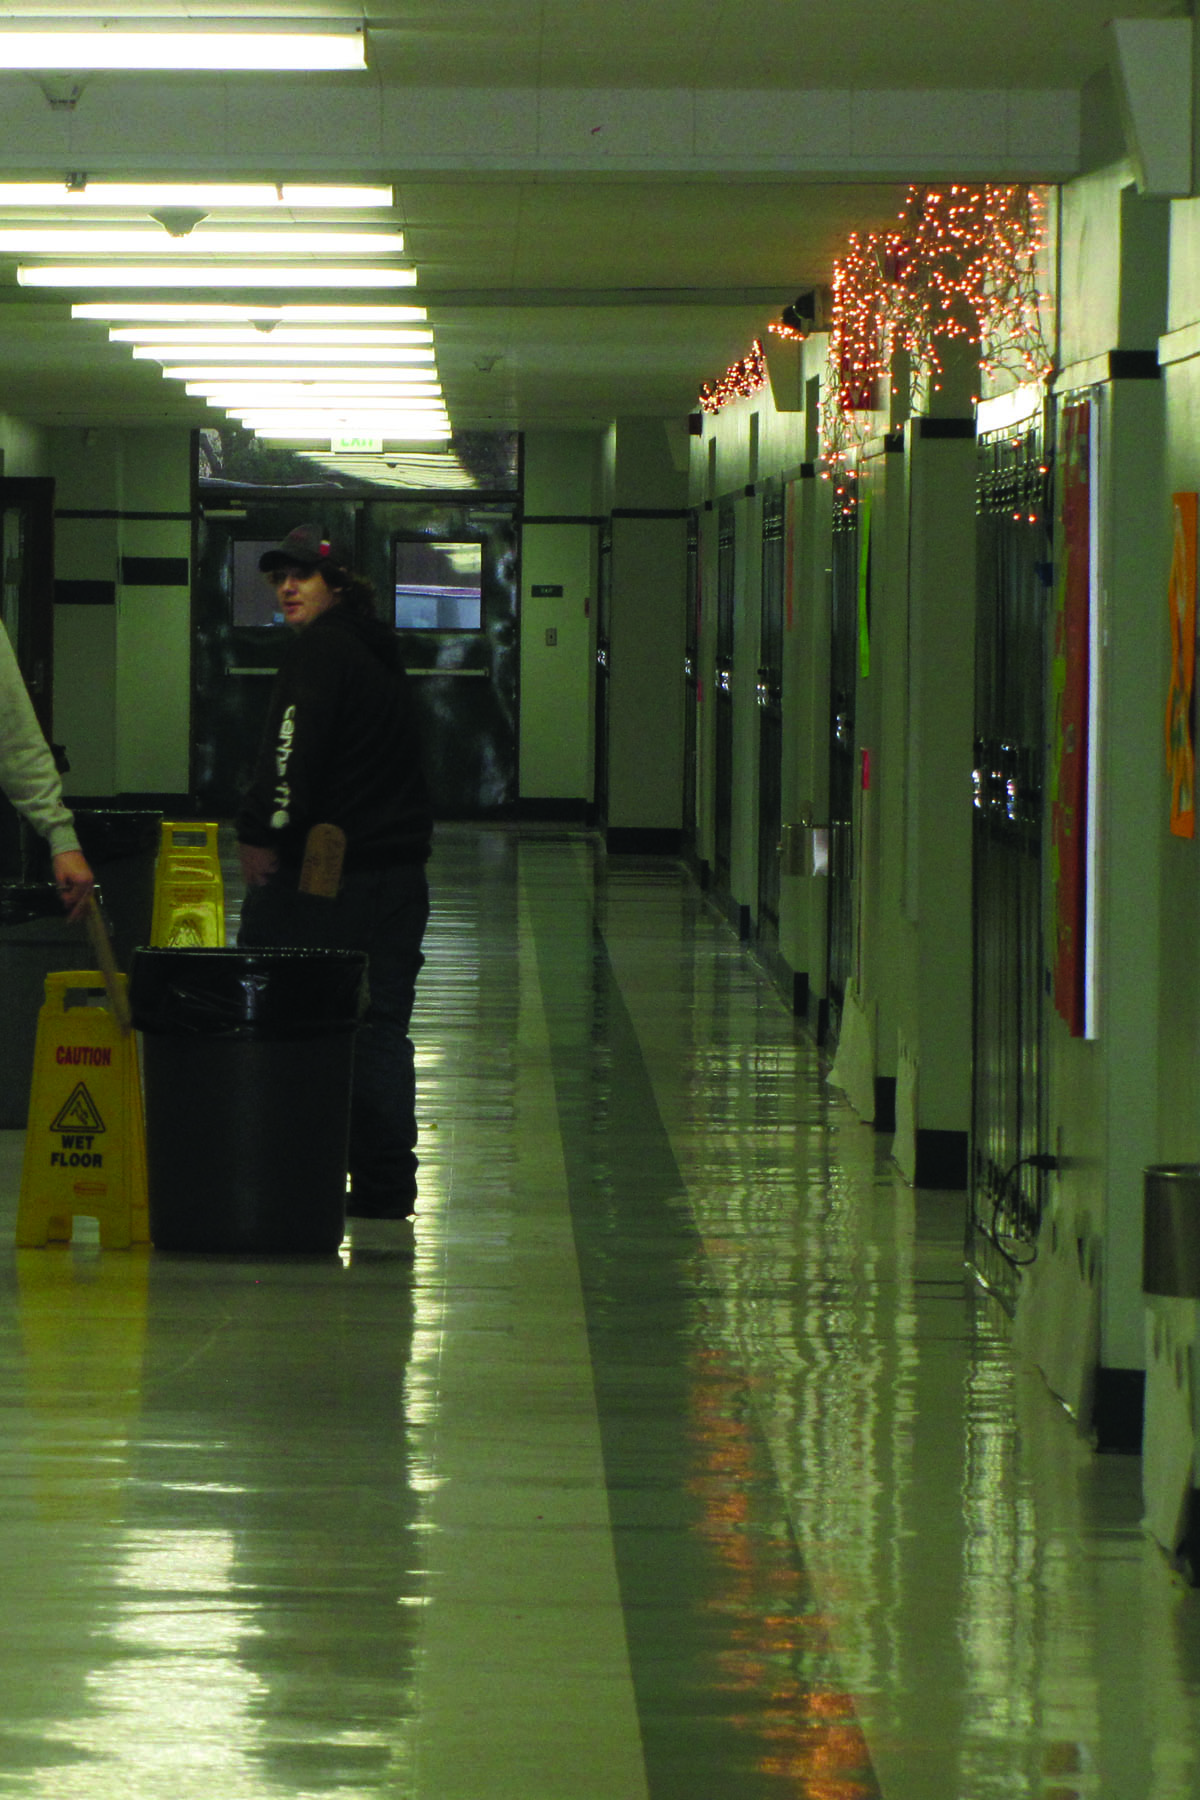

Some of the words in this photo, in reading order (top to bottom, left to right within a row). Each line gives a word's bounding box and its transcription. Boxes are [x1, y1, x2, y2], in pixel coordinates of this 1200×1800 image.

[57, 1046, 111, 1066] CAUTION
[62, 1135, 94, 1149] WET
[51, 1153, 102, 1167] FLOOR
